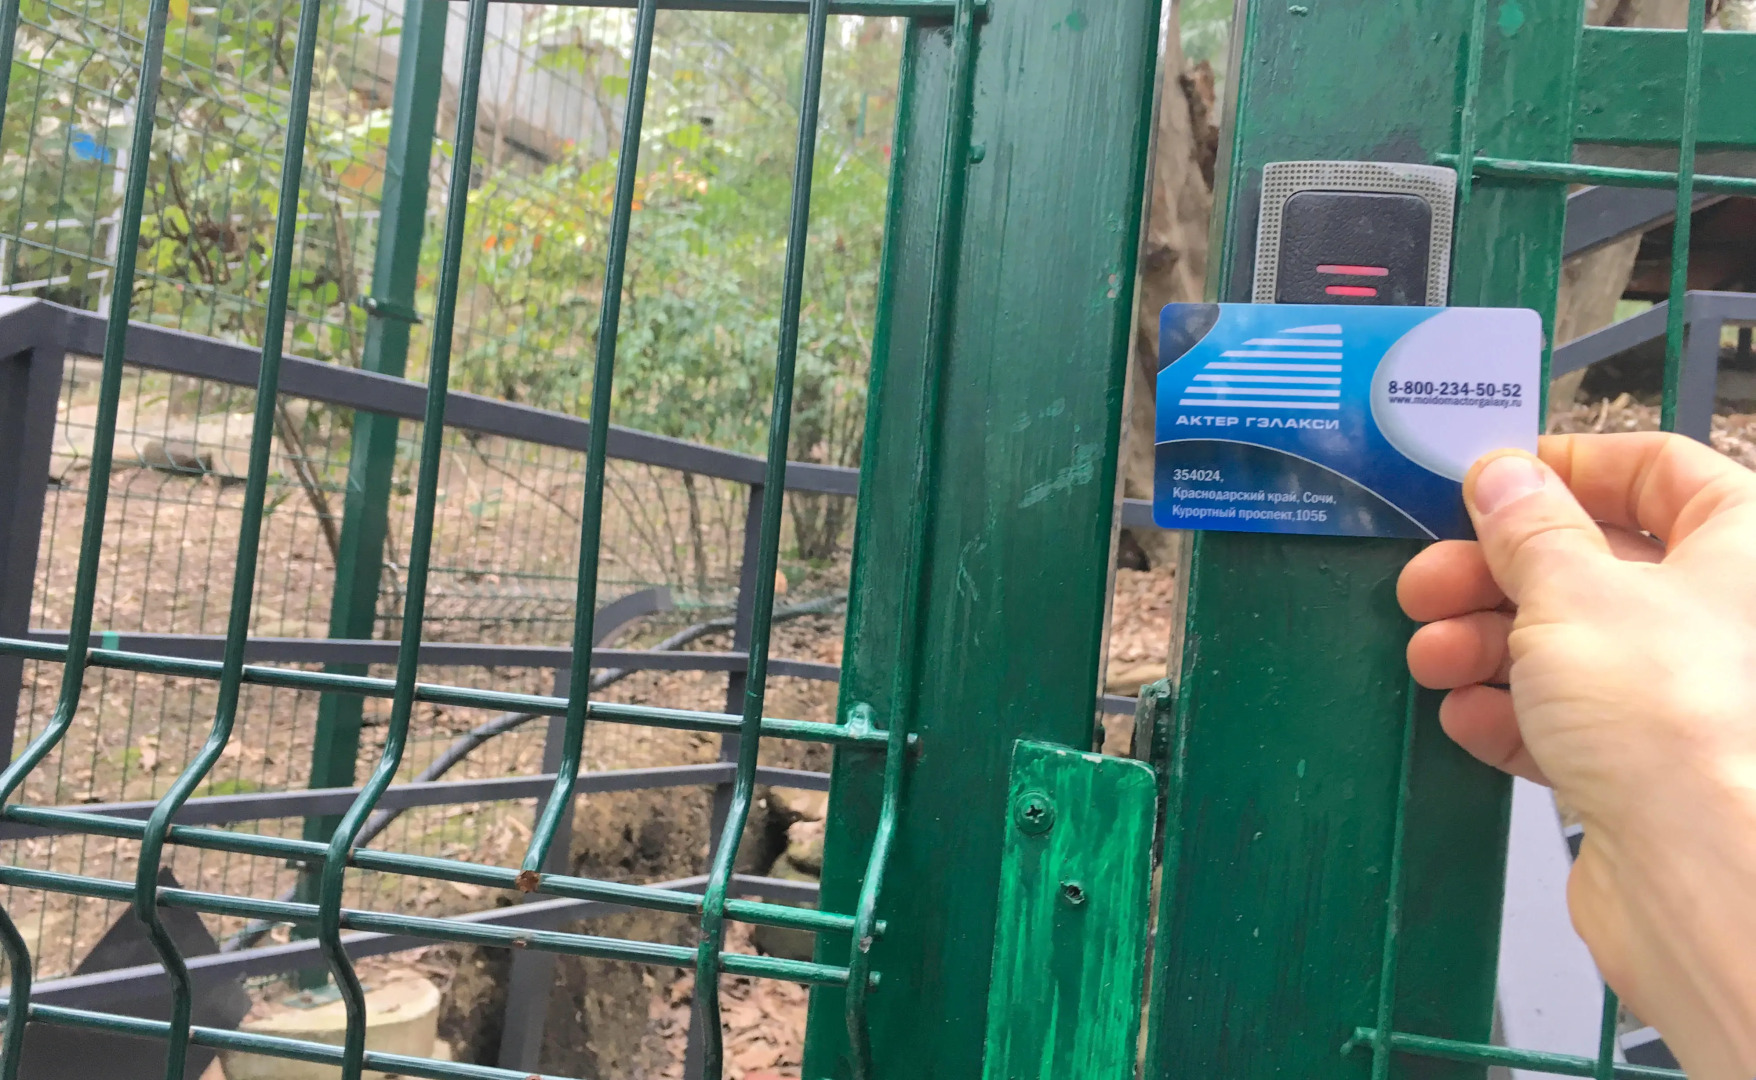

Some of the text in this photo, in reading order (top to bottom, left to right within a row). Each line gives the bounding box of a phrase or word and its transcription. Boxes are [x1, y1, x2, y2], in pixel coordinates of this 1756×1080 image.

[1388, 380, 1522, 397] 8-800-234-50-52
[1176, 415, 1340, 430] АКТЕР ГЭЛАКСИ
[1173, 469, 1224, 483] 354024,
[1173, 487, 1337, 505] Краснодарский край, Сочи,
[1172, 505, 1236, 519] Курортный
